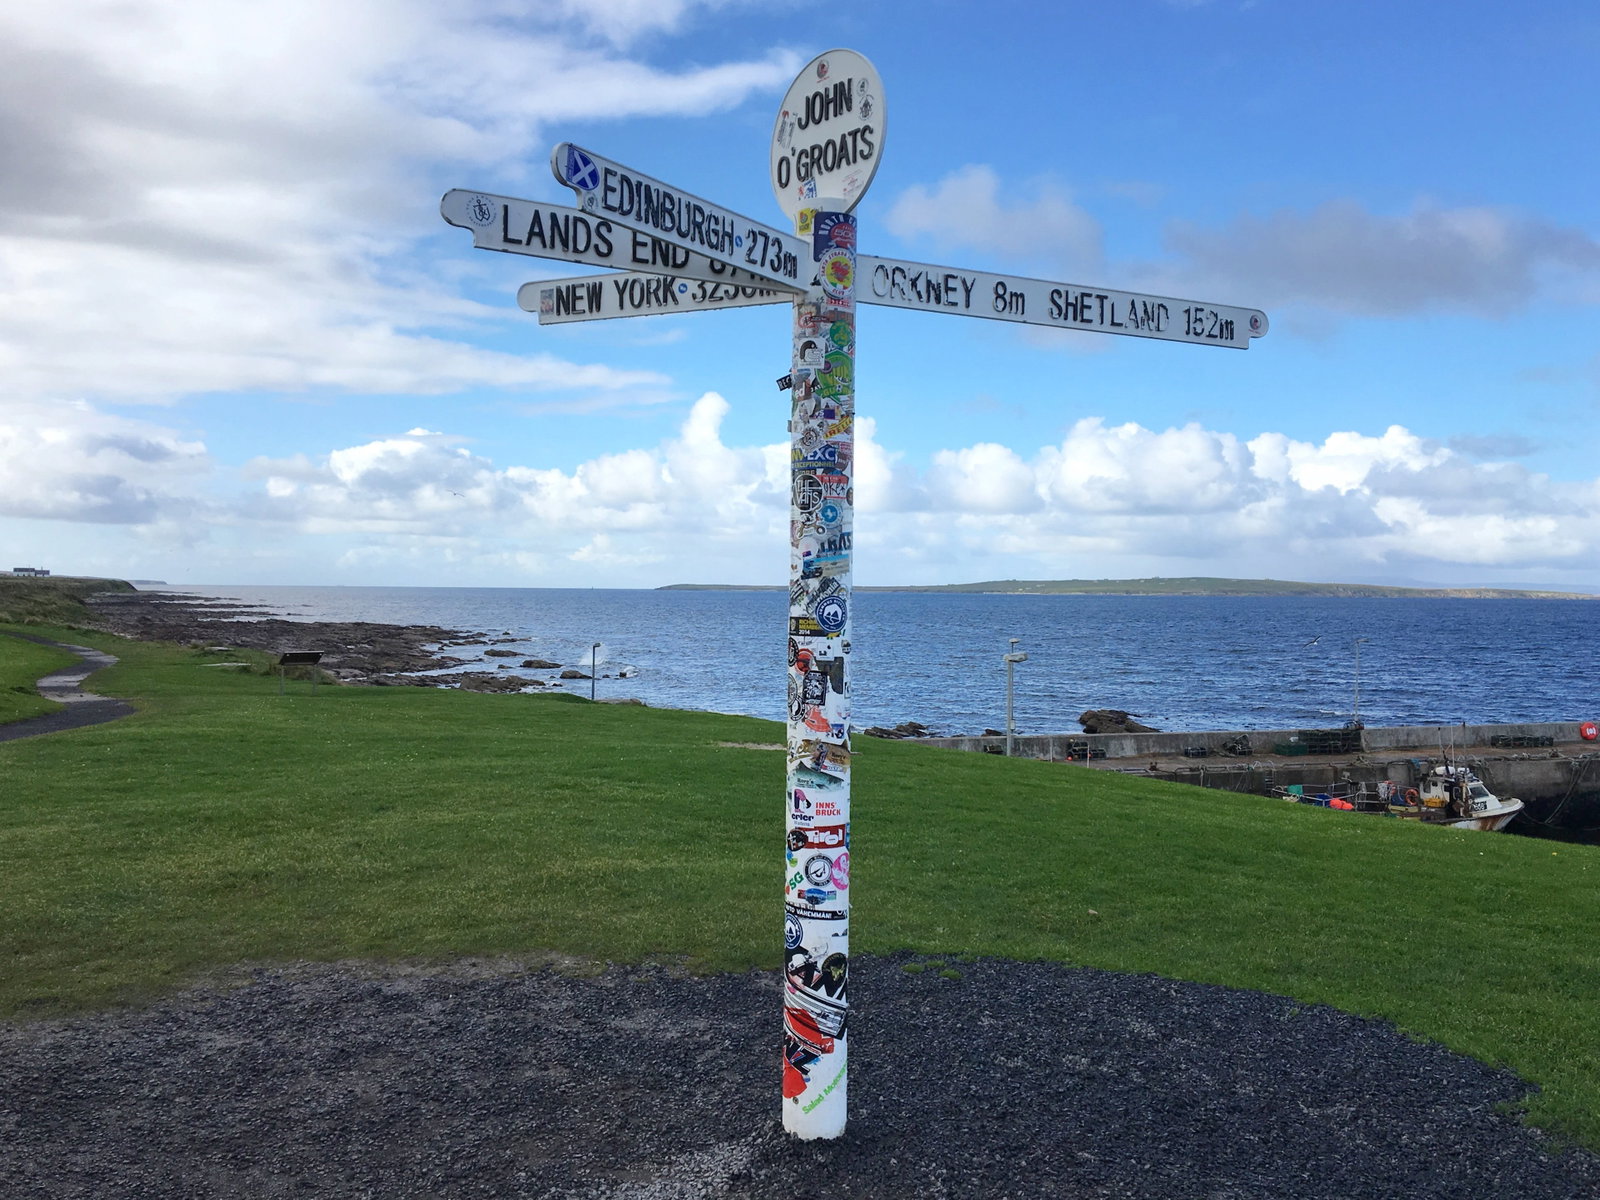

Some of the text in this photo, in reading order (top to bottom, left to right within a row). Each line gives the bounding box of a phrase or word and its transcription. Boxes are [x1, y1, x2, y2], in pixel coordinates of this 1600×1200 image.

[797, 78, 852, 130] JOHN
[777, 124, 874, 189] O'GROATS
[502, 204, 613, 258] LANDS
[631, 230, 690, 269] END
[602, 167, 798, 280] EDINBURGH 273m
[554, 281, 603, 317] NEW
[613, 275, 679, 310] YORK
[872, 264, 1235, 341] ORKNEY 8m SHETLAND 152m
[815, 808, 841, 817] BRUCK
